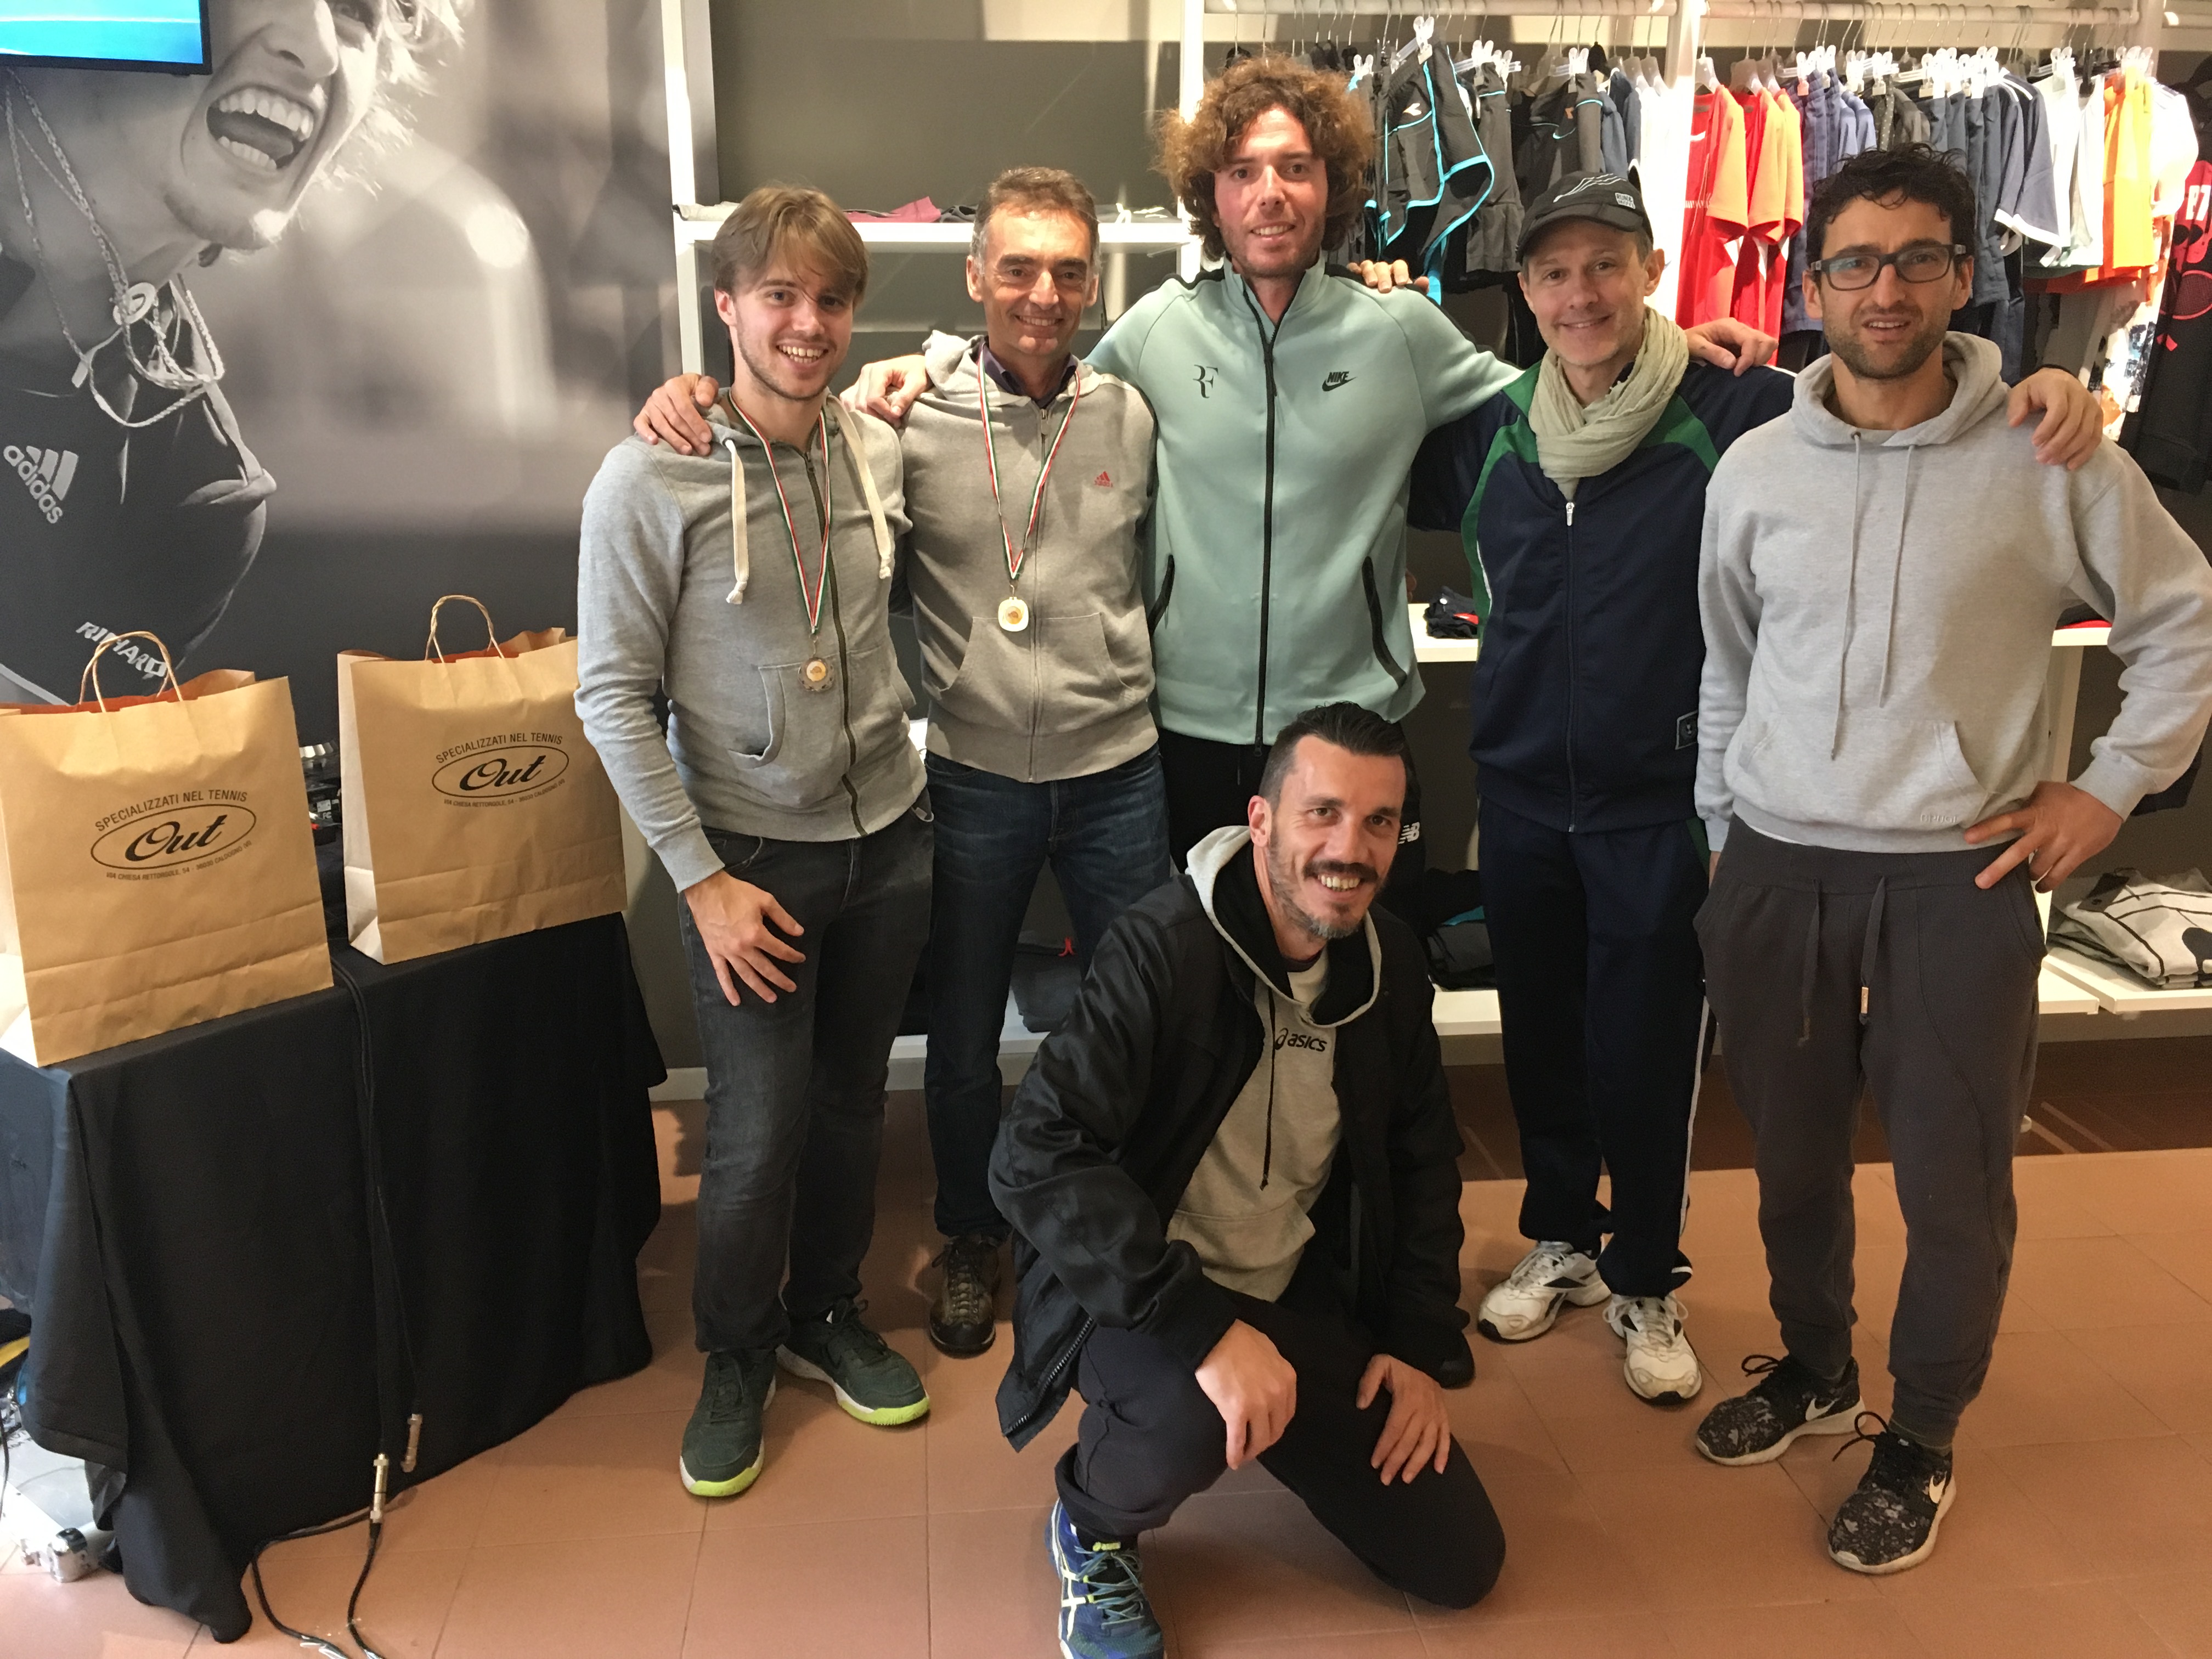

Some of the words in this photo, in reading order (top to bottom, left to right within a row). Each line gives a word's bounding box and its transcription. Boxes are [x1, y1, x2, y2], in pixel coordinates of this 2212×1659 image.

[1327, 371, 1350, 383] NIKE
[3, 445, 63, 524] adidas
[436, 735, 506, 763] SPECIALIZZATI
[510, 733, 527, 742] NEL
[531, 732, 562, 744] TENNIS
[459, 755, 546, 791] Out
[95, 794, 179, 832] SPECIALIZZATI
[183, 791, 204, 803] NEL
[208, 789, 248, 802] TENNIS
[125, 814, 228, 862] Out
[1287, 1033, 1328, 1052] asics
